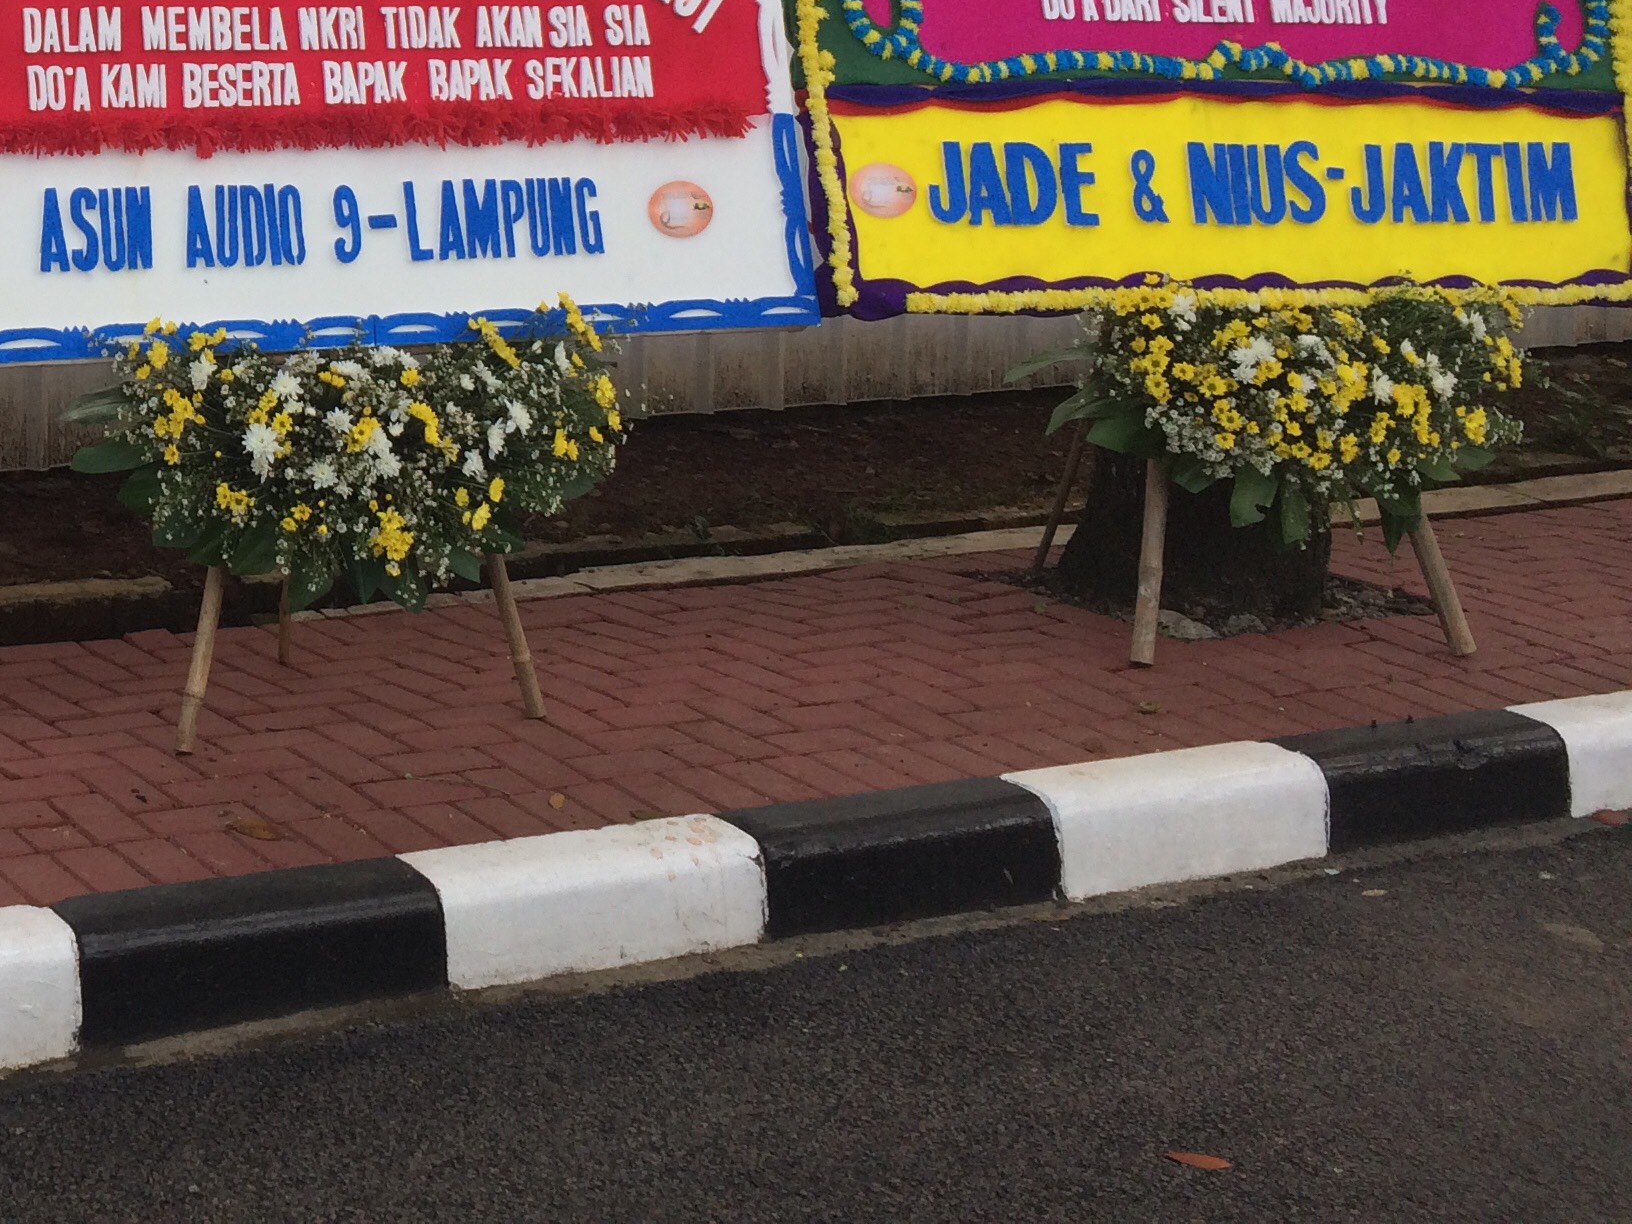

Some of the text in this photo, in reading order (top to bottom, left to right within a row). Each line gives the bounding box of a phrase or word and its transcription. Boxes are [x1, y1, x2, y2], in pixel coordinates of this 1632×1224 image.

[22, 3, 652, 54] DALAM MEMBELA NKRI TIDAK AKAN SIA SIA
[100, 63, 167, 109] KAMI
[182, 61, 301, 109] BESERTA
[322, 60, 408, 106] BAPAK
[429, 58, 513, 102] BAPAK
[928, 141, 1100, 227] JADE
[1130, 149, 1168, 223] &
[39, 186, 153, 274] ASUN
[185, 184, 306, 269] AUDIO
